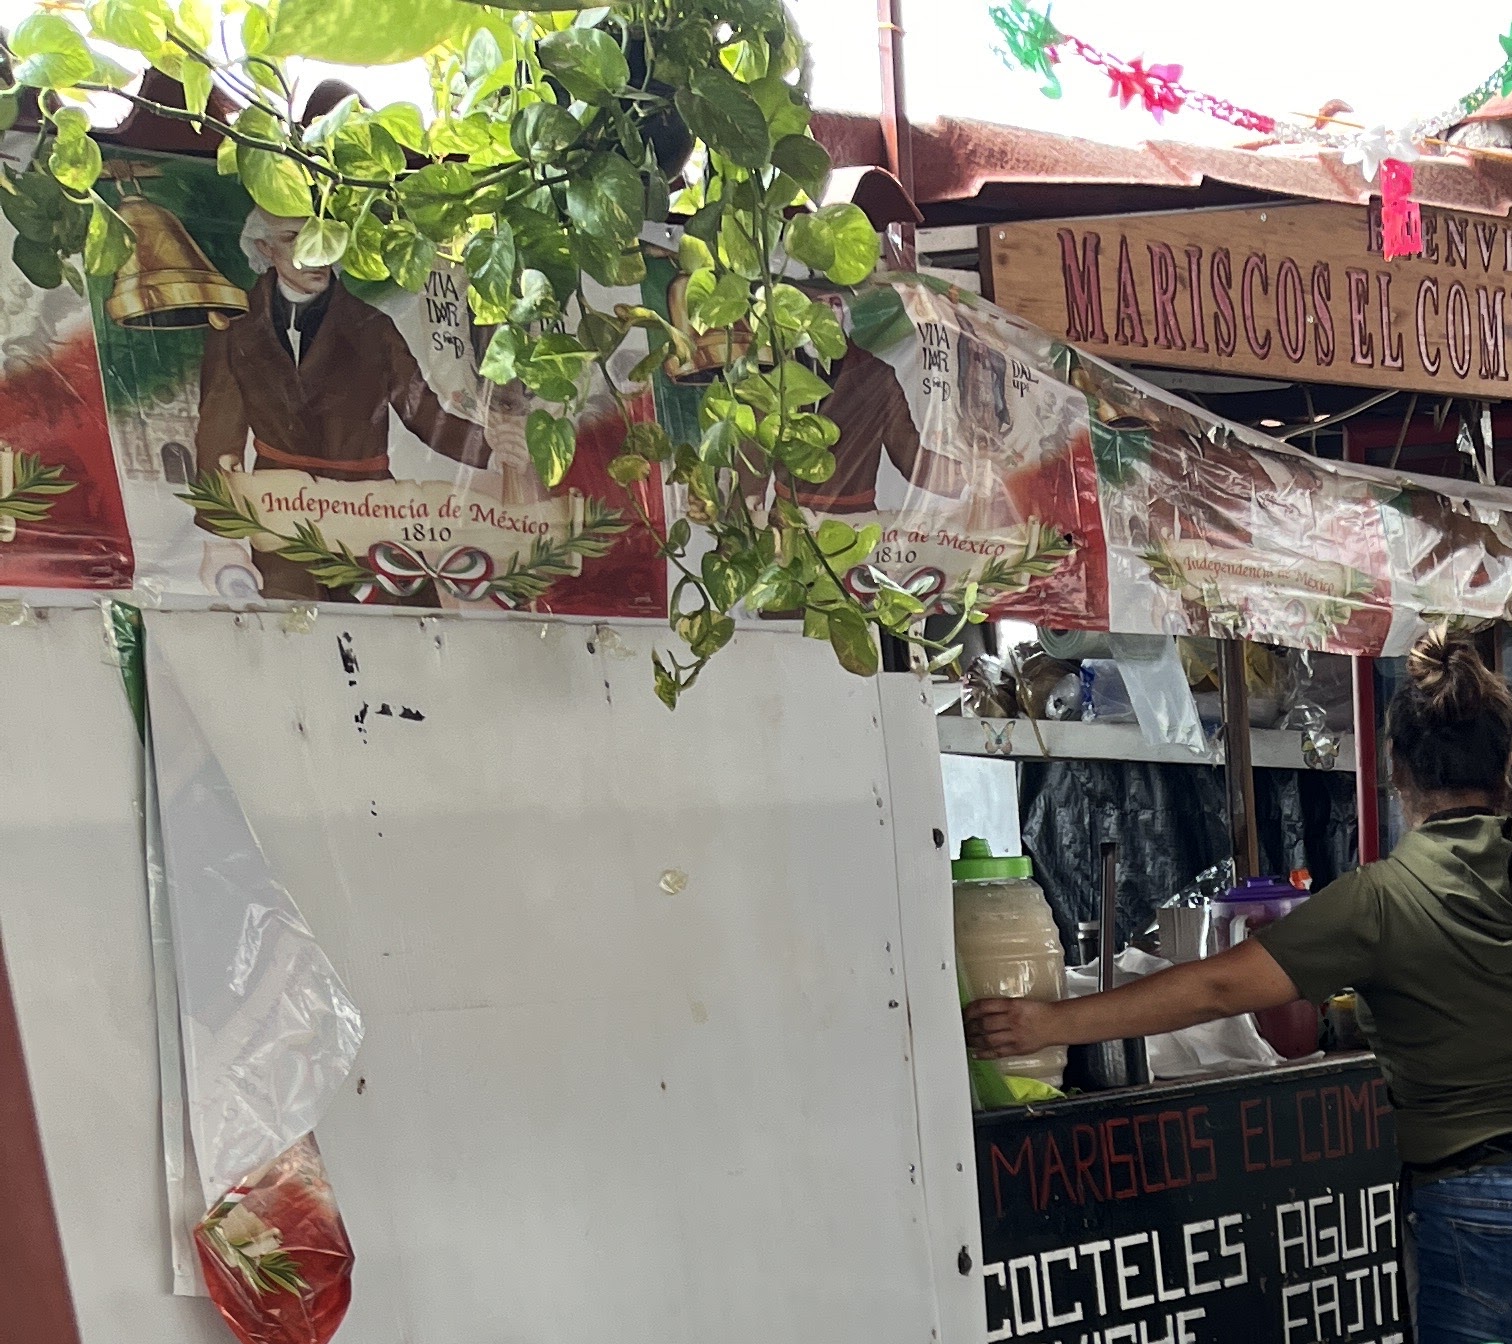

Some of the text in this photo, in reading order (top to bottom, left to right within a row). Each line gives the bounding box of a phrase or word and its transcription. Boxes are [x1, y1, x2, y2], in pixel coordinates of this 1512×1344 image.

[1057, 227, 1335, 367] MARISCOS
[1345, 267, 1404, 372] EL
[261, 487, 550, 536] Independencia de México
[401, 523, 452, 542] 1810
[936, 529, 1007, 557] México
[874, 547, 917, 564] 1810
[990, 1105, 1218, 1221] MARISCOS
[1240, 1094, 1293, 1173] EL
[1275, 1181, 1400, 1274] AGUA
[983, 1212, 1249, 1343] COCTELES
